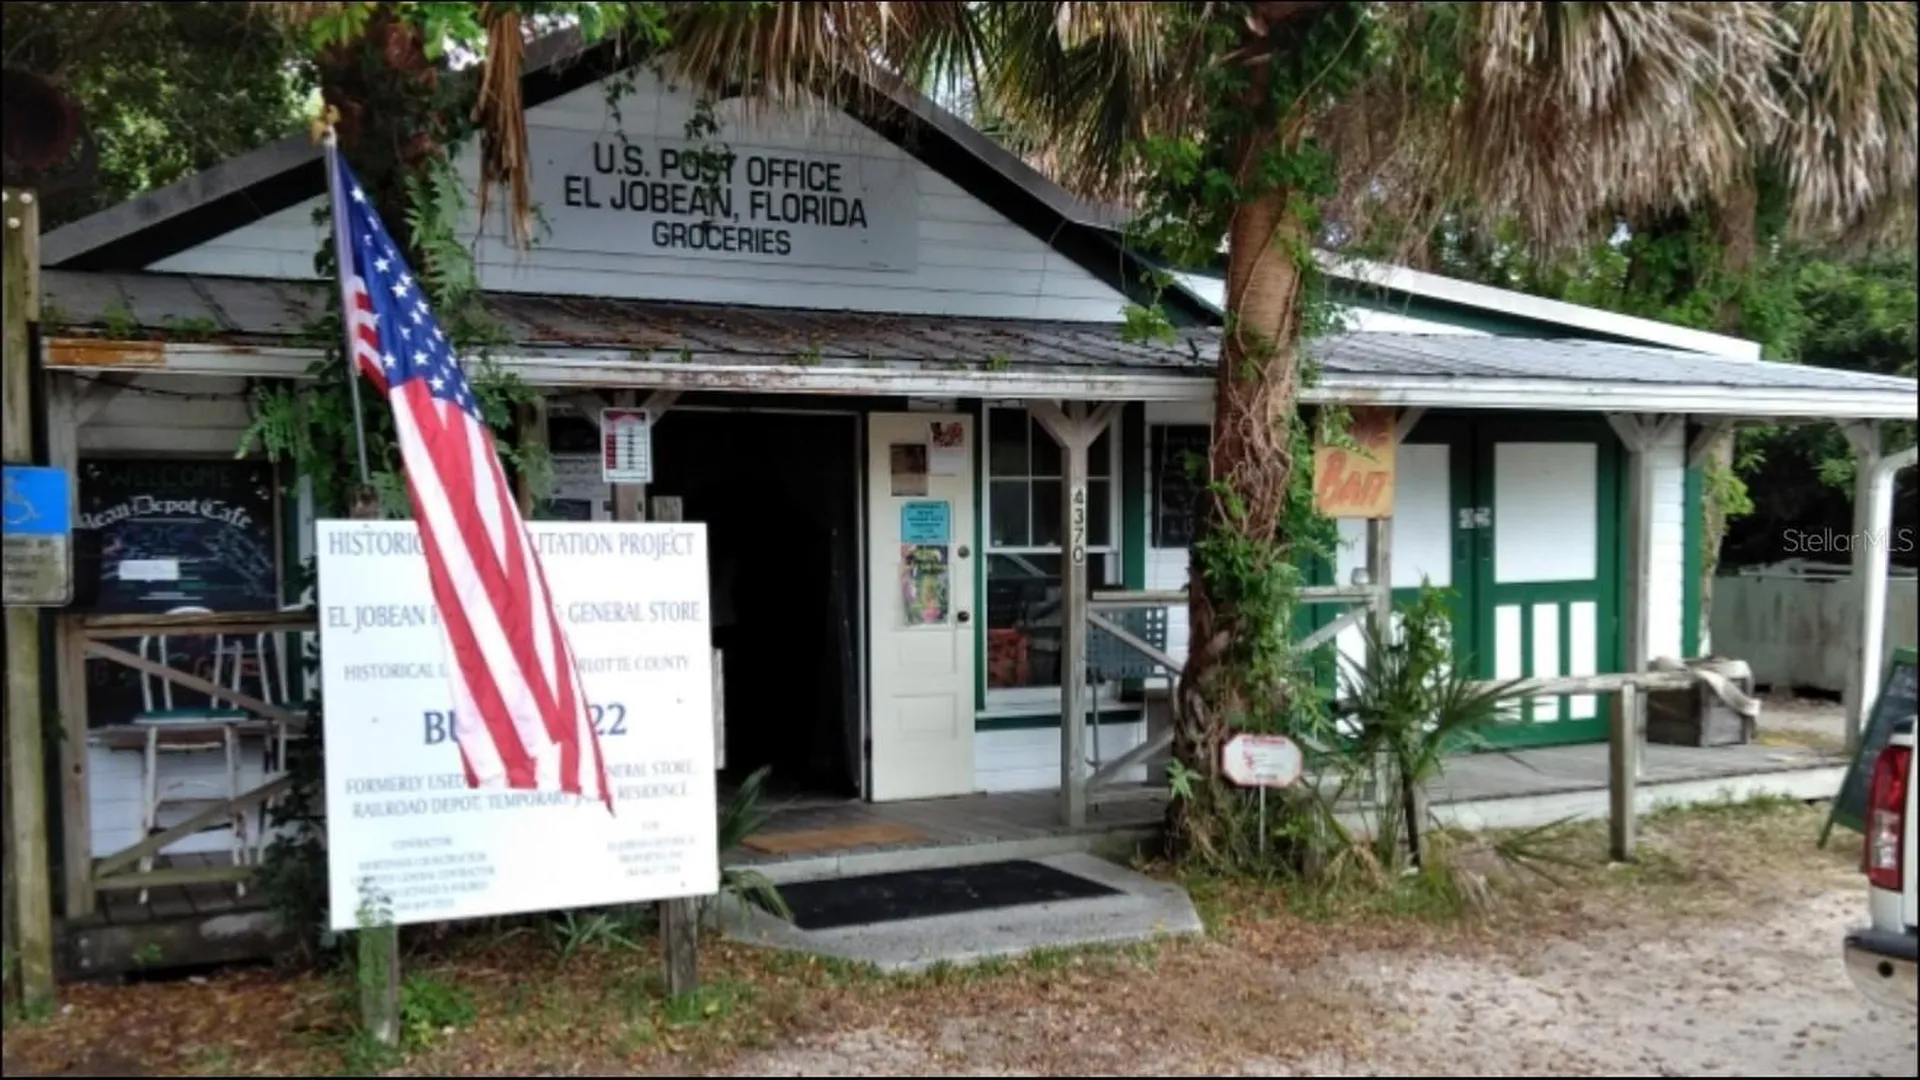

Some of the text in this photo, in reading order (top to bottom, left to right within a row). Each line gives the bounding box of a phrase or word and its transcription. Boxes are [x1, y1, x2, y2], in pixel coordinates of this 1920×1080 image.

[593, 142, 841, 193] U.S. POST OFFICE
[563, 175, 868, 229] EL JOBEAN, FLORIDA
[652, 221, 792, 256] GROCERIES
[105, 464, 234, 488] WELCOME
[132, 494, 198, 516] Depot
[200, 500, 253, 529] Cafe
[1073, 488, 1084, 564] 4370
[619, 530, 695, 561] PROJECT
[327, 606, 351, 628] EL
[352, 604, 427, 634] JOBEAN
[567, 601, 645, 623] GENERAL
[649, 600, 702, 622] STORE
[344, 663, 435, 682] HISTORICAL
[634, 654, 690, 671] COUNTY
[589, 702, 628, 735] 22
[345, 775, 424, 795] FORMERLY
[353, 799, 429, 818] RAILROAD
[617, 781, 689, 800] RESIDENCE
